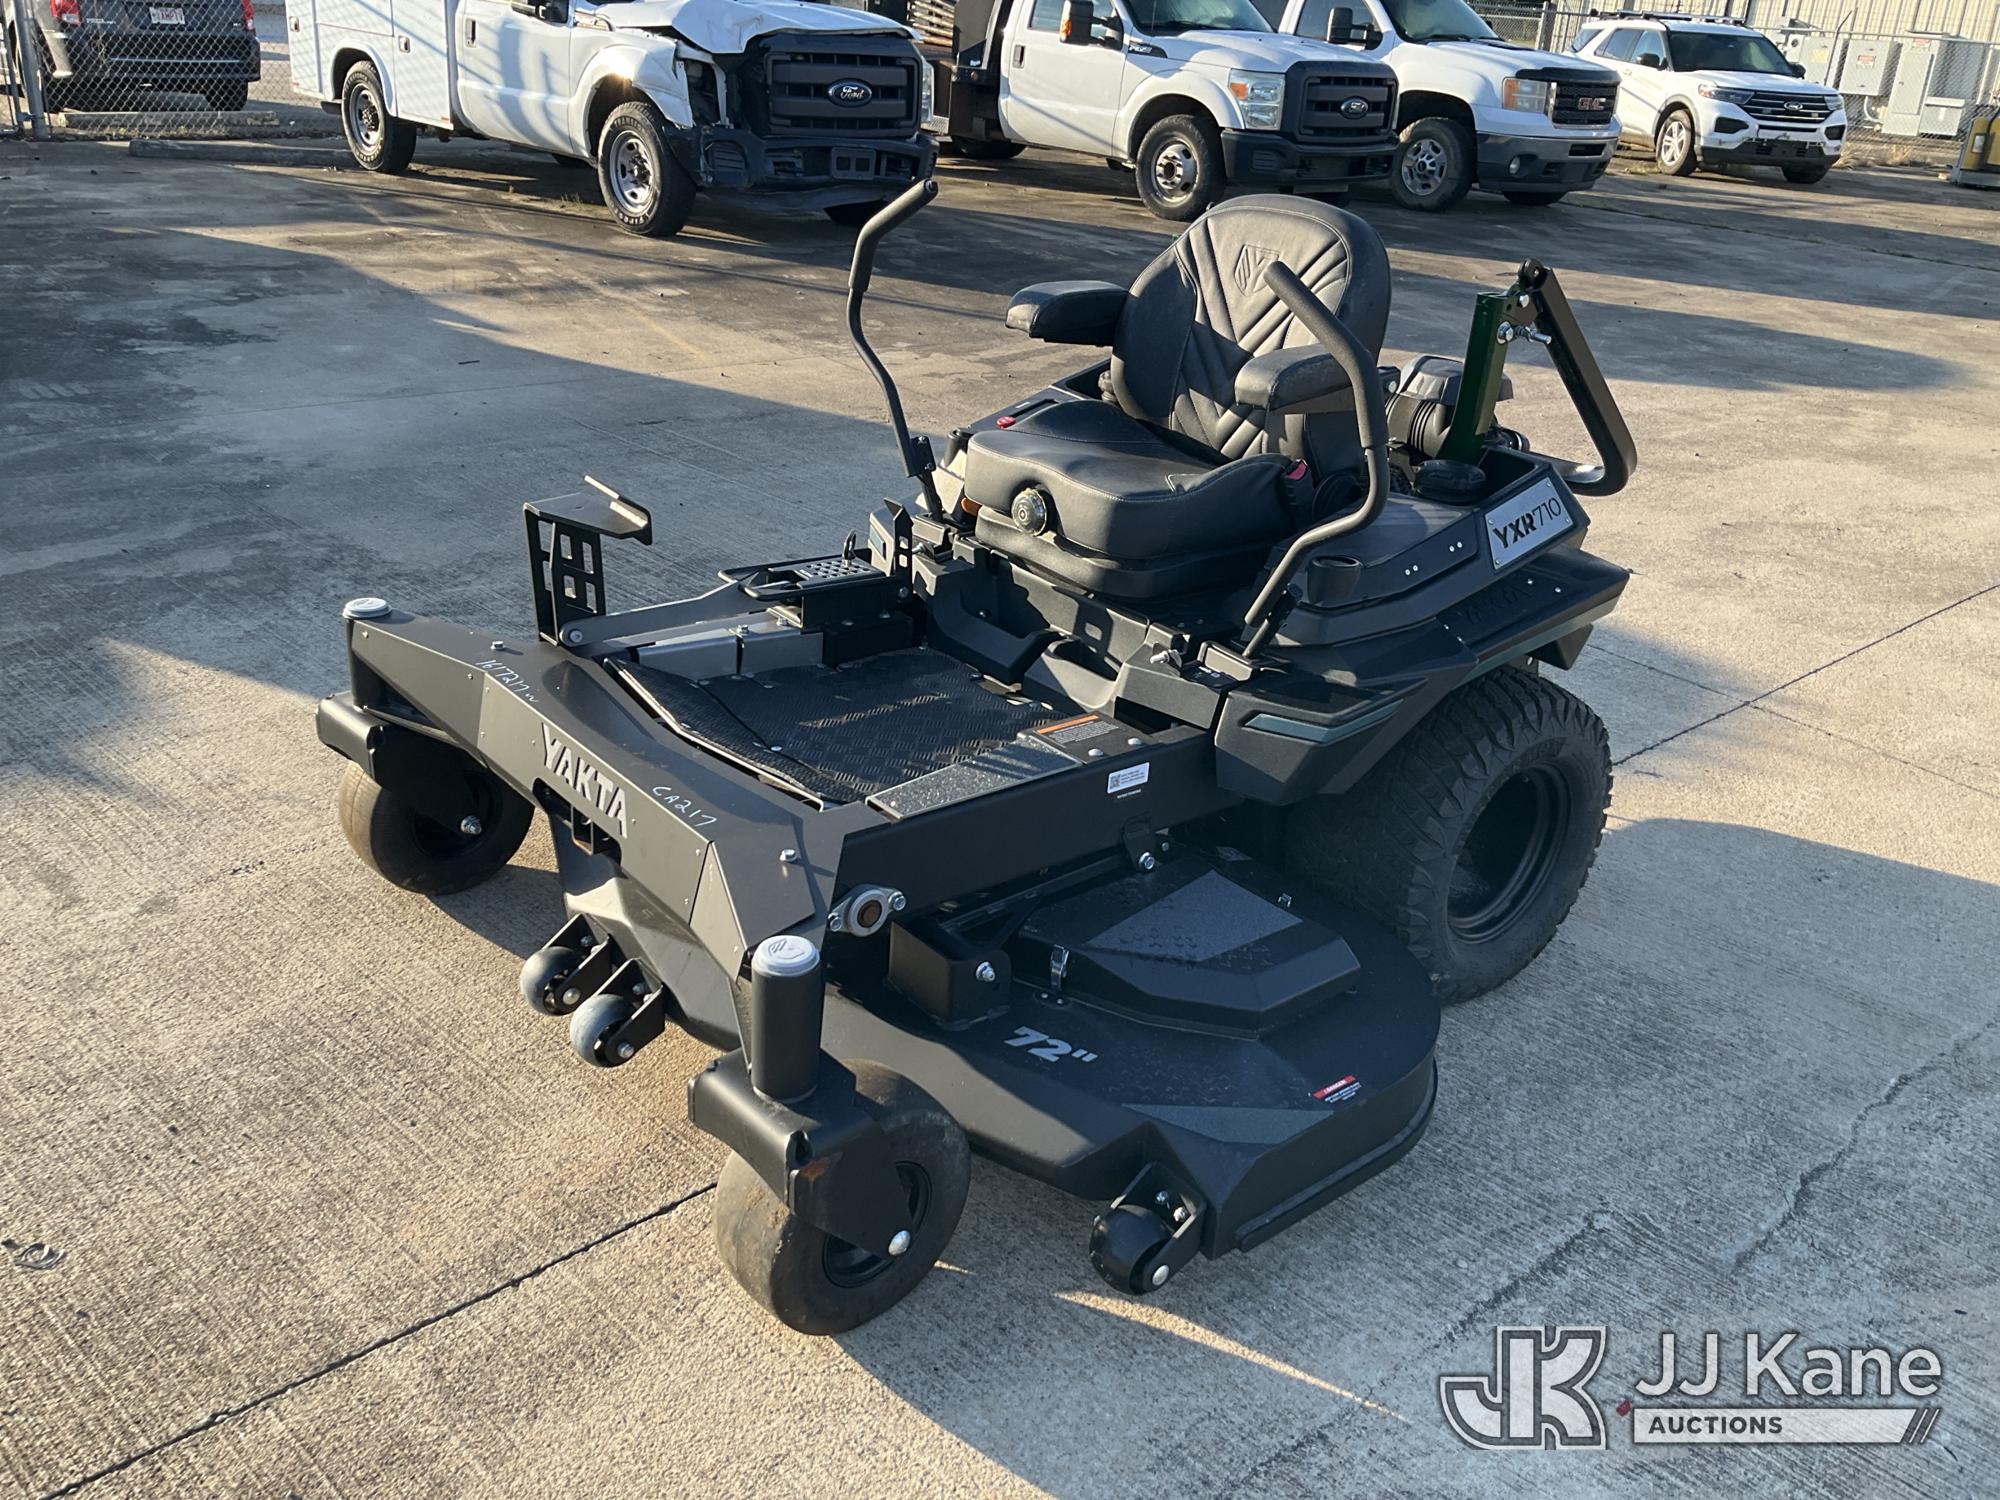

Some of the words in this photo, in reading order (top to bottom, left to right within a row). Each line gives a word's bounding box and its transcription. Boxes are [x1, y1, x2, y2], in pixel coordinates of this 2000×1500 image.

[840, 86, 864, 100] Ford
[1492, 497, 1562, 549] YXR710
[541, 722, 628, 839] YAKTA
[652, 786, 718, 827] CA217
